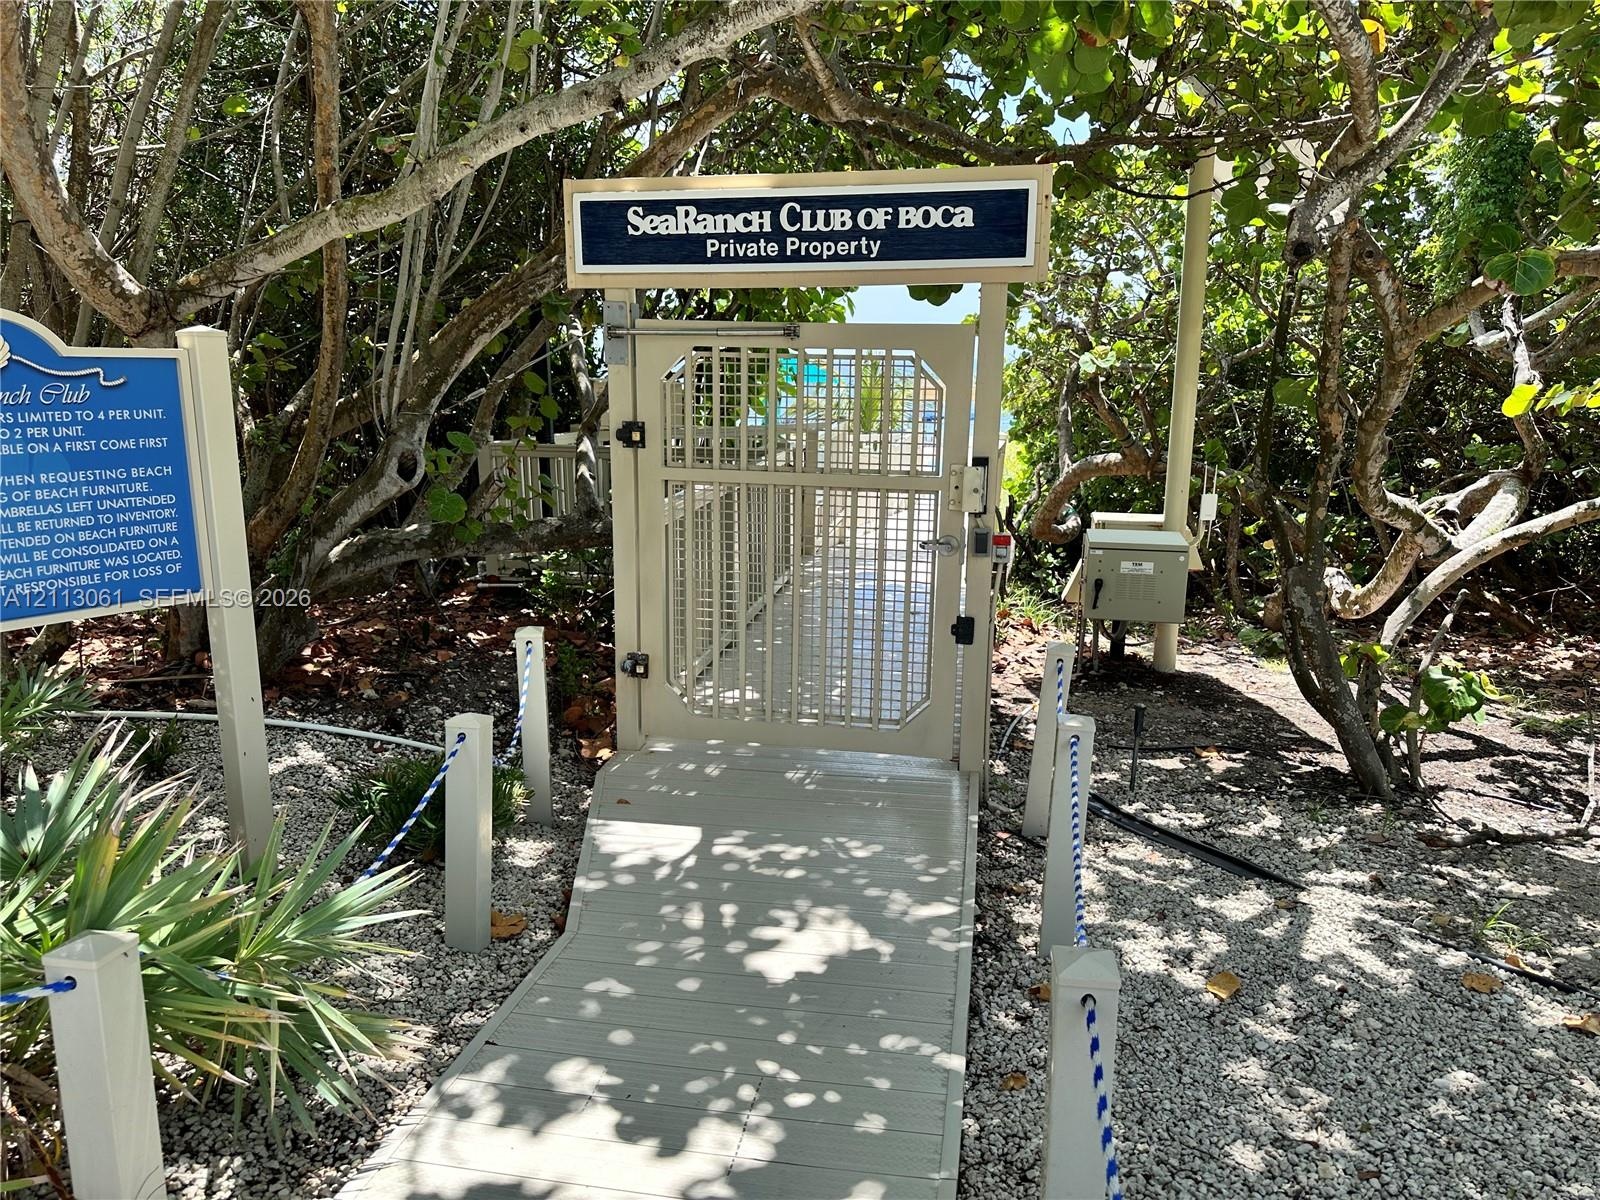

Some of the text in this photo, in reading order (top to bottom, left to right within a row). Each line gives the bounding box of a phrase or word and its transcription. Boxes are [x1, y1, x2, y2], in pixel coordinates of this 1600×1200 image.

[857, 208, 893, 230] OF
[707, 237, 880, 259] Private Property
[40, 383, 90, 404] Club
[18, 411, 72, 422] LIMITED
[75, 411, 93, 420] TO
[98, 411, 104, 420] 4
[109, 410, 130, 419] PER
[134, 409, 166, 419] UNIT.
[14, 428, 22, 438] 2
[27, 428, 49, 438] PER
[53, 426, 85, 437] UNIT.
[0, 438, 167, 455] BLE ON A FIRST COME FIRST
[40, 469, 126, 484] REQUESTING
[131, 466, 171, 477] BEACH
[12, 491, 31, 501] OF
[35, 487, 78, 500] BEACH
[82, 482, 152, 496] FURNITURE.
[67, 501, 93, 512] LEFT
[97, 495, 175, 510] UNATTENDED
[0, 508, 178, 534] LL BE RETURNED TO INVENTORY.
[55, 533, 75, 543] ON
[79, 528, 116, 541] BEACH
[120, 522, 177, 536] FURNITURE
[0, 537, 179, 565] WILL BE CONSOLIDATED ON A
[37, 559, 100, 576] FURNITURE
[104, 556, 129, 567] WAS
[133, 550, 182, 564] LOCATED.
[15, 573, 101, 594] RESPONSIBLE
[105, 570, 129, 582] FOR
[133, 566, 162, 578] LOSS
[166, 563, 181, 573] OF
